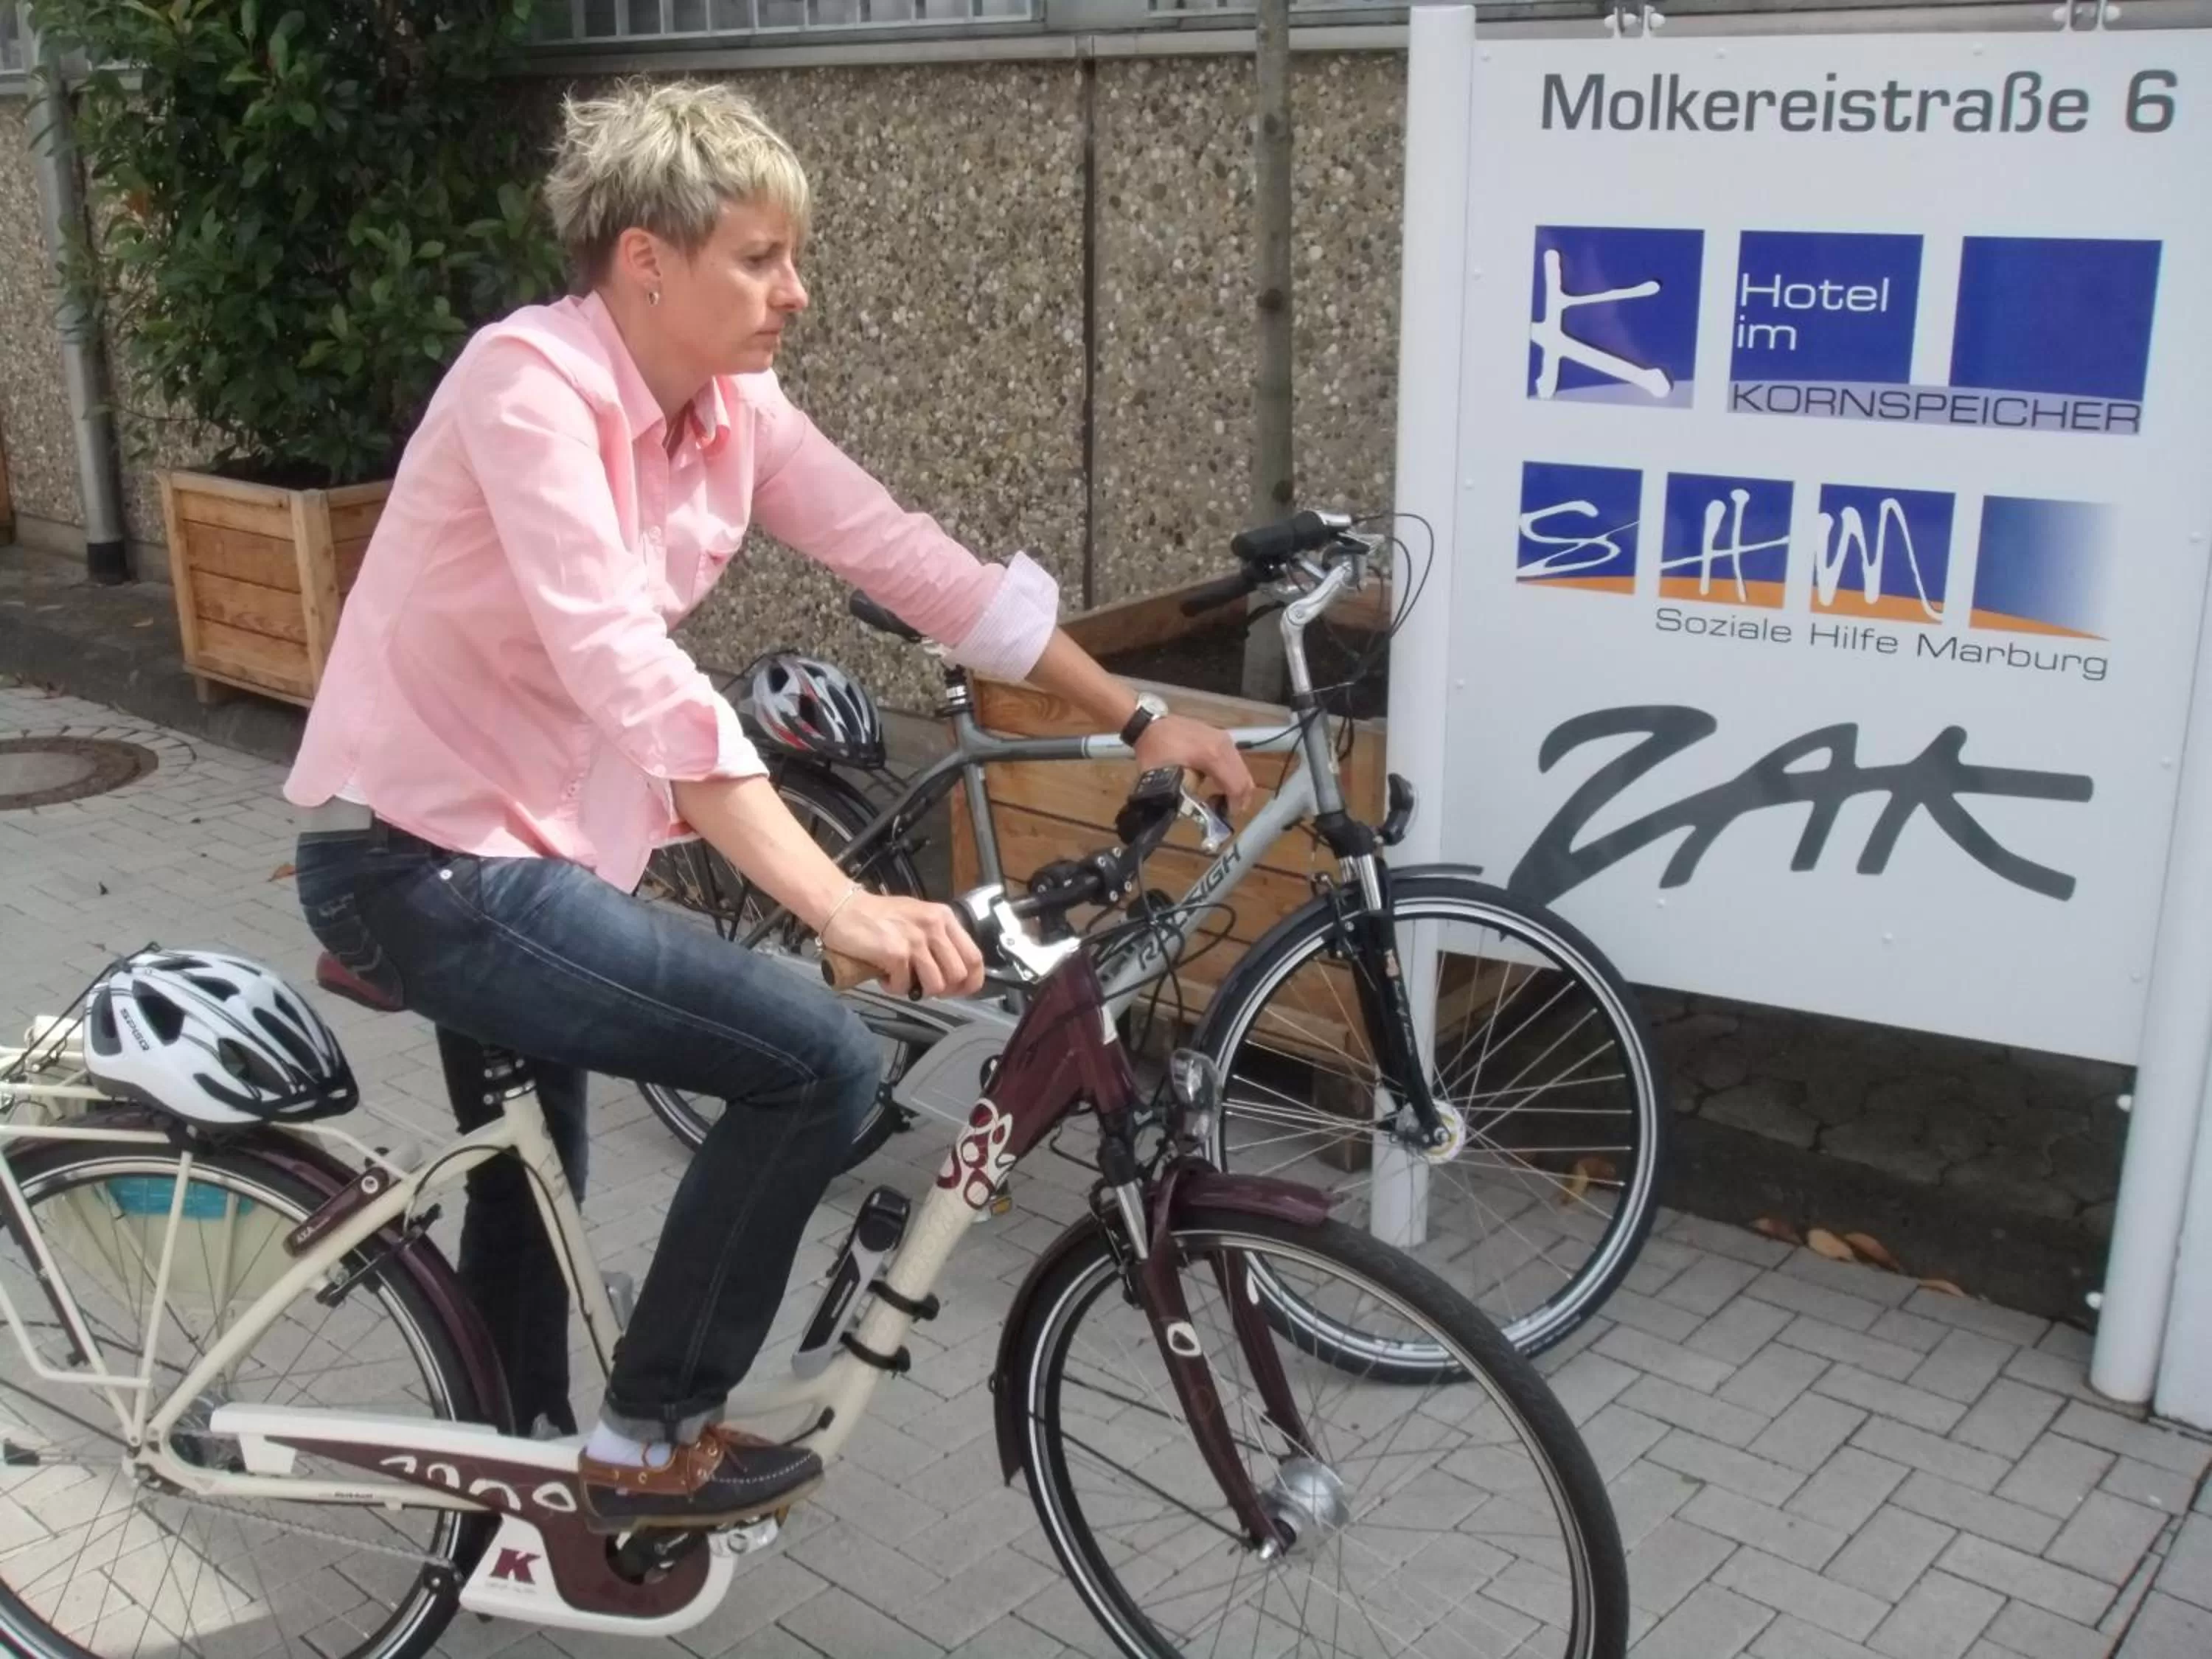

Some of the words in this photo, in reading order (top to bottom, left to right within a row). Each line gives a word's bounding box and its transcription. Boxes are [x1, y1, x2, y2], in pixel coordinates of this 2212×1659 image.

[1541, 70, 2089, 133] Molkereistraße
[2125, 69, 2178, 133] 6
[1741, 273, 1889, 312] Hotel
[1737, 315, 1796, 350] im
[1733, 383, 2142, 434] KORNSPEICHER
[1655, 608, 1792, 644] Soziale
[1810, 622, 1899, 655] Hilfe
[1917, 633, 2109, 681] Marburg
[1507, 705, 2094, 908] ZAK
[488, 1548, 541, 1585] K
